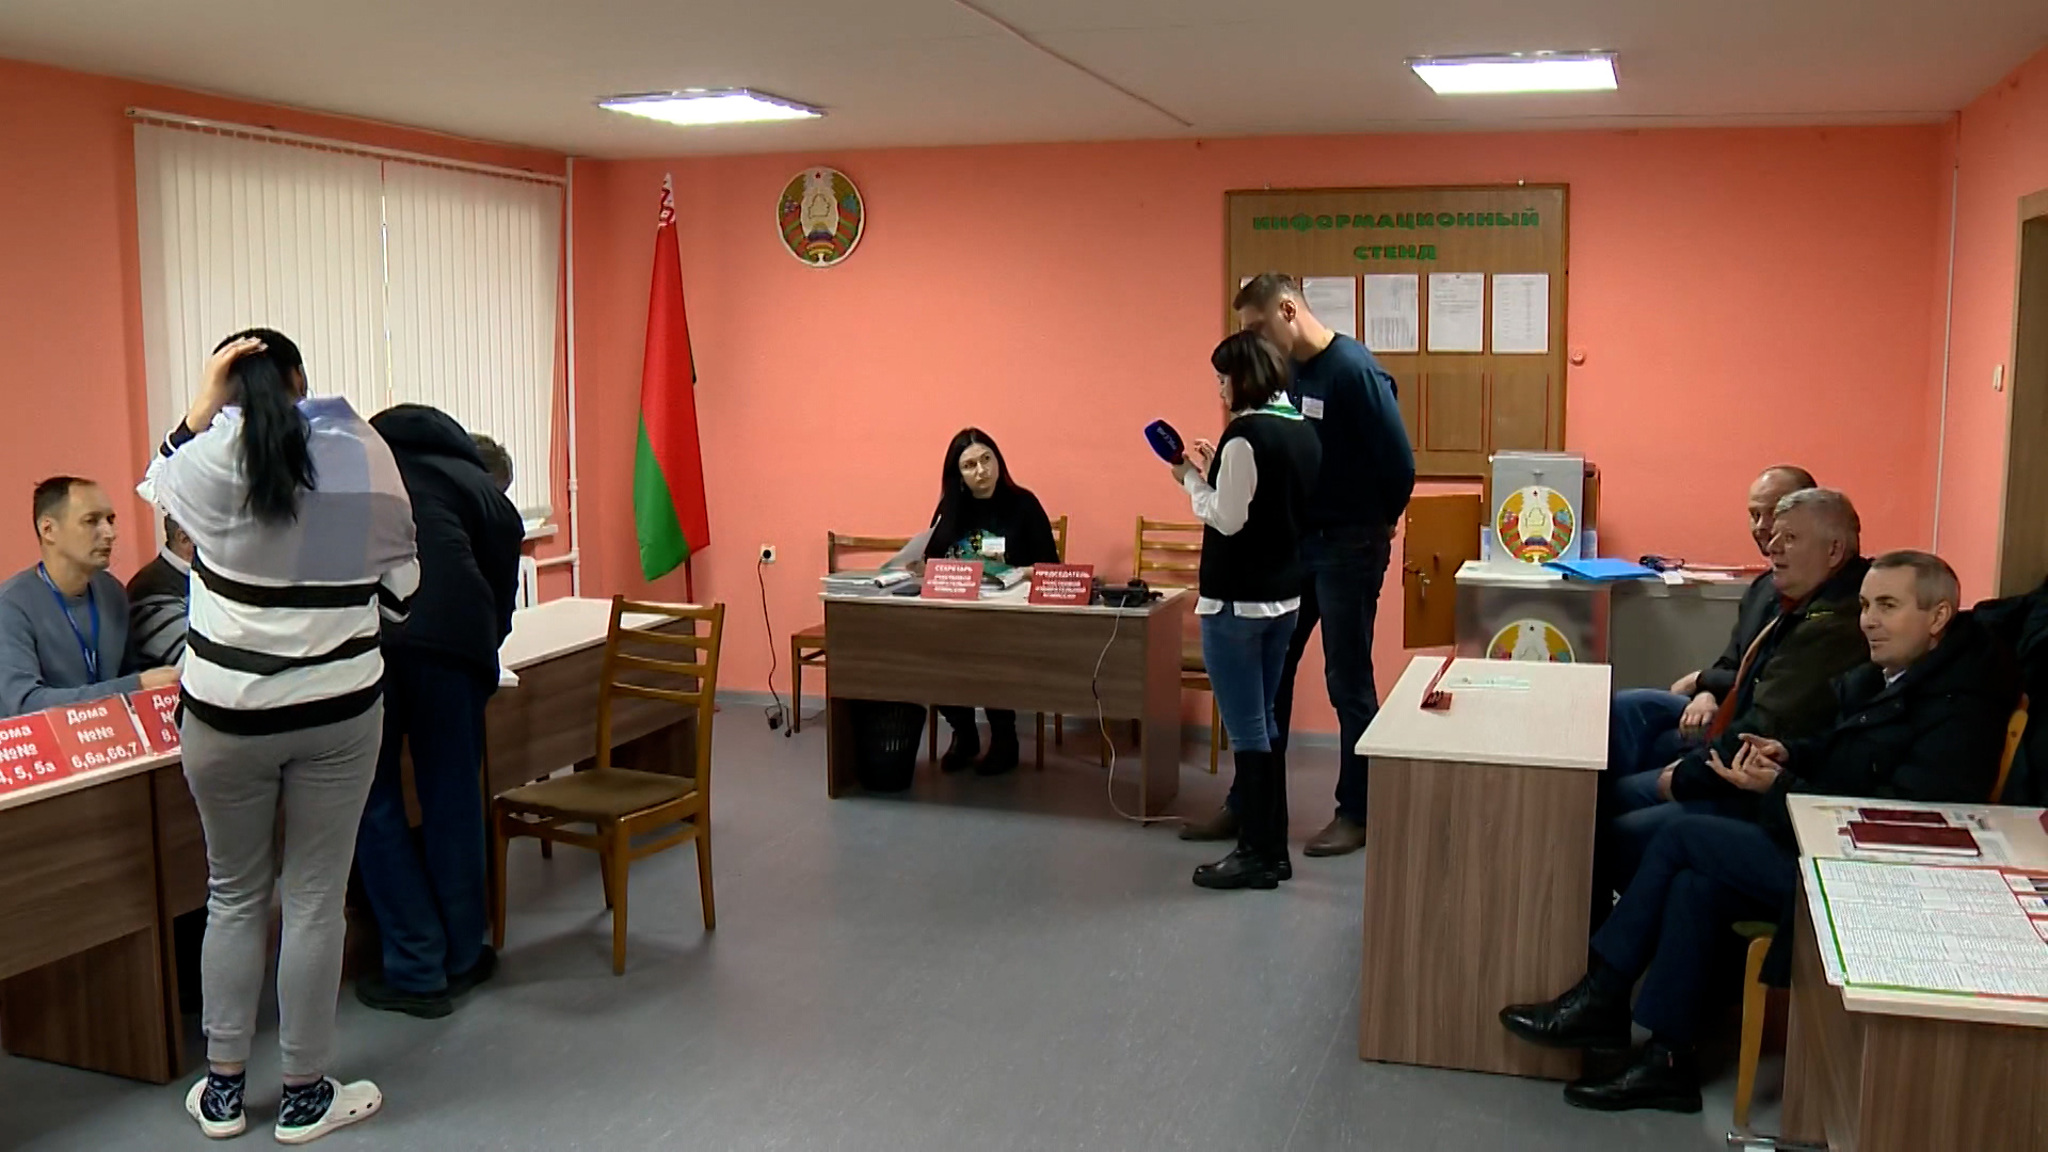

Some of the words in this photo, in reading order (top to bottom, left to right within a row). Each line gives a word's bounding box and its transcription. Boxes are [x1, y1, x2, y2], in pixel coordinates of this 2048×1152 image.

[1253, 208, 1540, 232] ИНФОРМАЦИОННЫЙ
[1353, 244, 1438, 261] СТЕНД
[66, 706, 109, 725] Дома
[0, 724, 33, 744] ома
